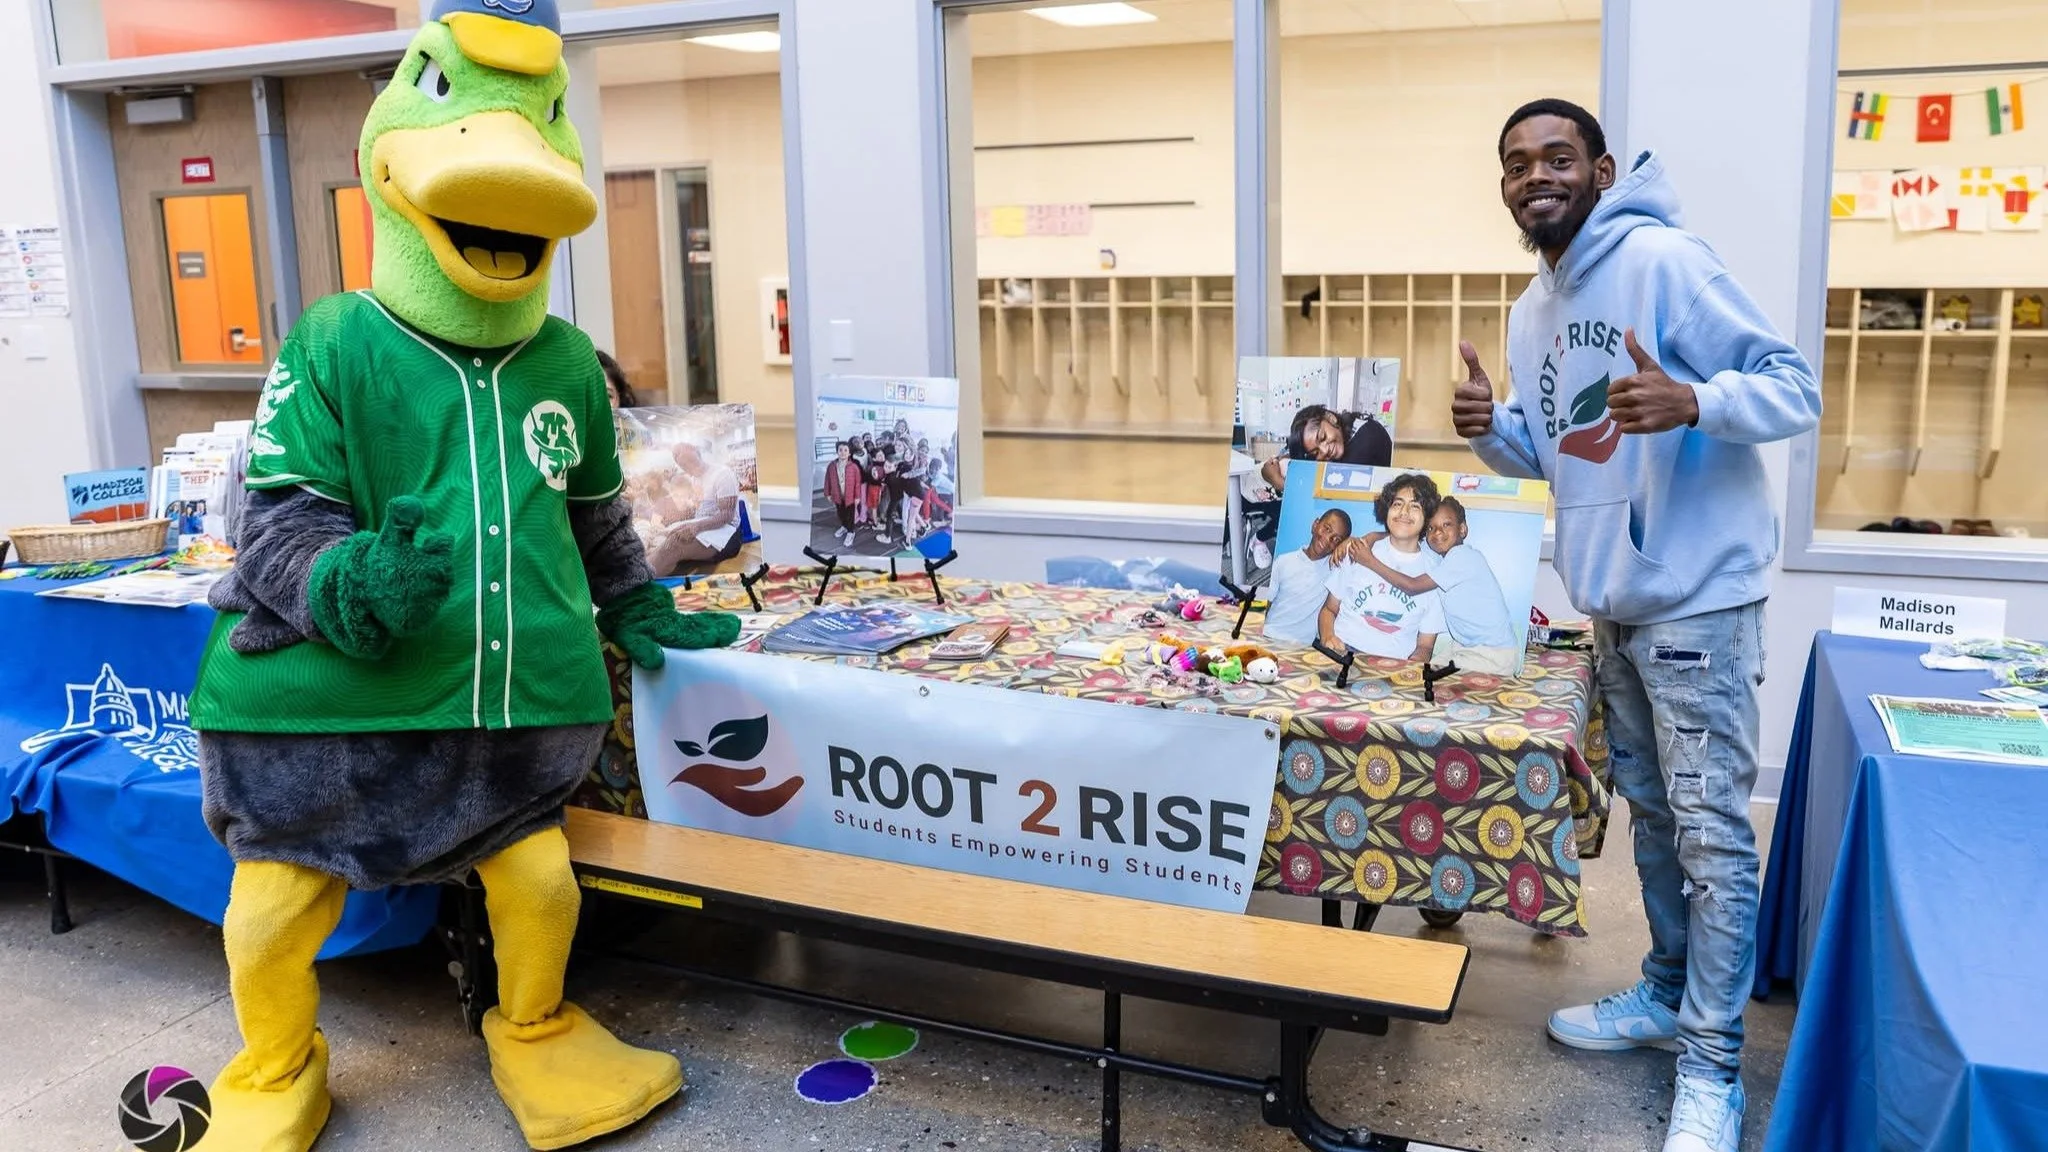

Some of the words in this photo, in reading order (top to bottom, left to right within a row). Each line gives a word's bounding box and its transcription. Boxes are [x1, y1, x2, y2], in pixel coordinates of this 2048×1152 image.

[1539, 353, 1559, 439] ROOT
[1555, 334, 1565, 359] 2
[1568, 320, 1622, 357] RISE
[886, 383, 925, 401] READ
[91, 477, 143, 492] MADISON
[93, 485, 145, 501] COLLEGE
[1378, 582, 1386, 595] 2
[1389, 584, 1417, 612] RISE
[1880, 597, 1956, 615] Madison
[1879, 616, 1954, 635] Mallards
[156, 690, 190, 721] MA
[827, 744, 997, 824] ROOT
[1018, 779, 1060, 836] 2
[1078, 785, 1250, 865] RISE
[834, 809, 937, 844] Students
[951, 833, 1110, 873] Empowering
[1126, 857, 1242, 896] Students
